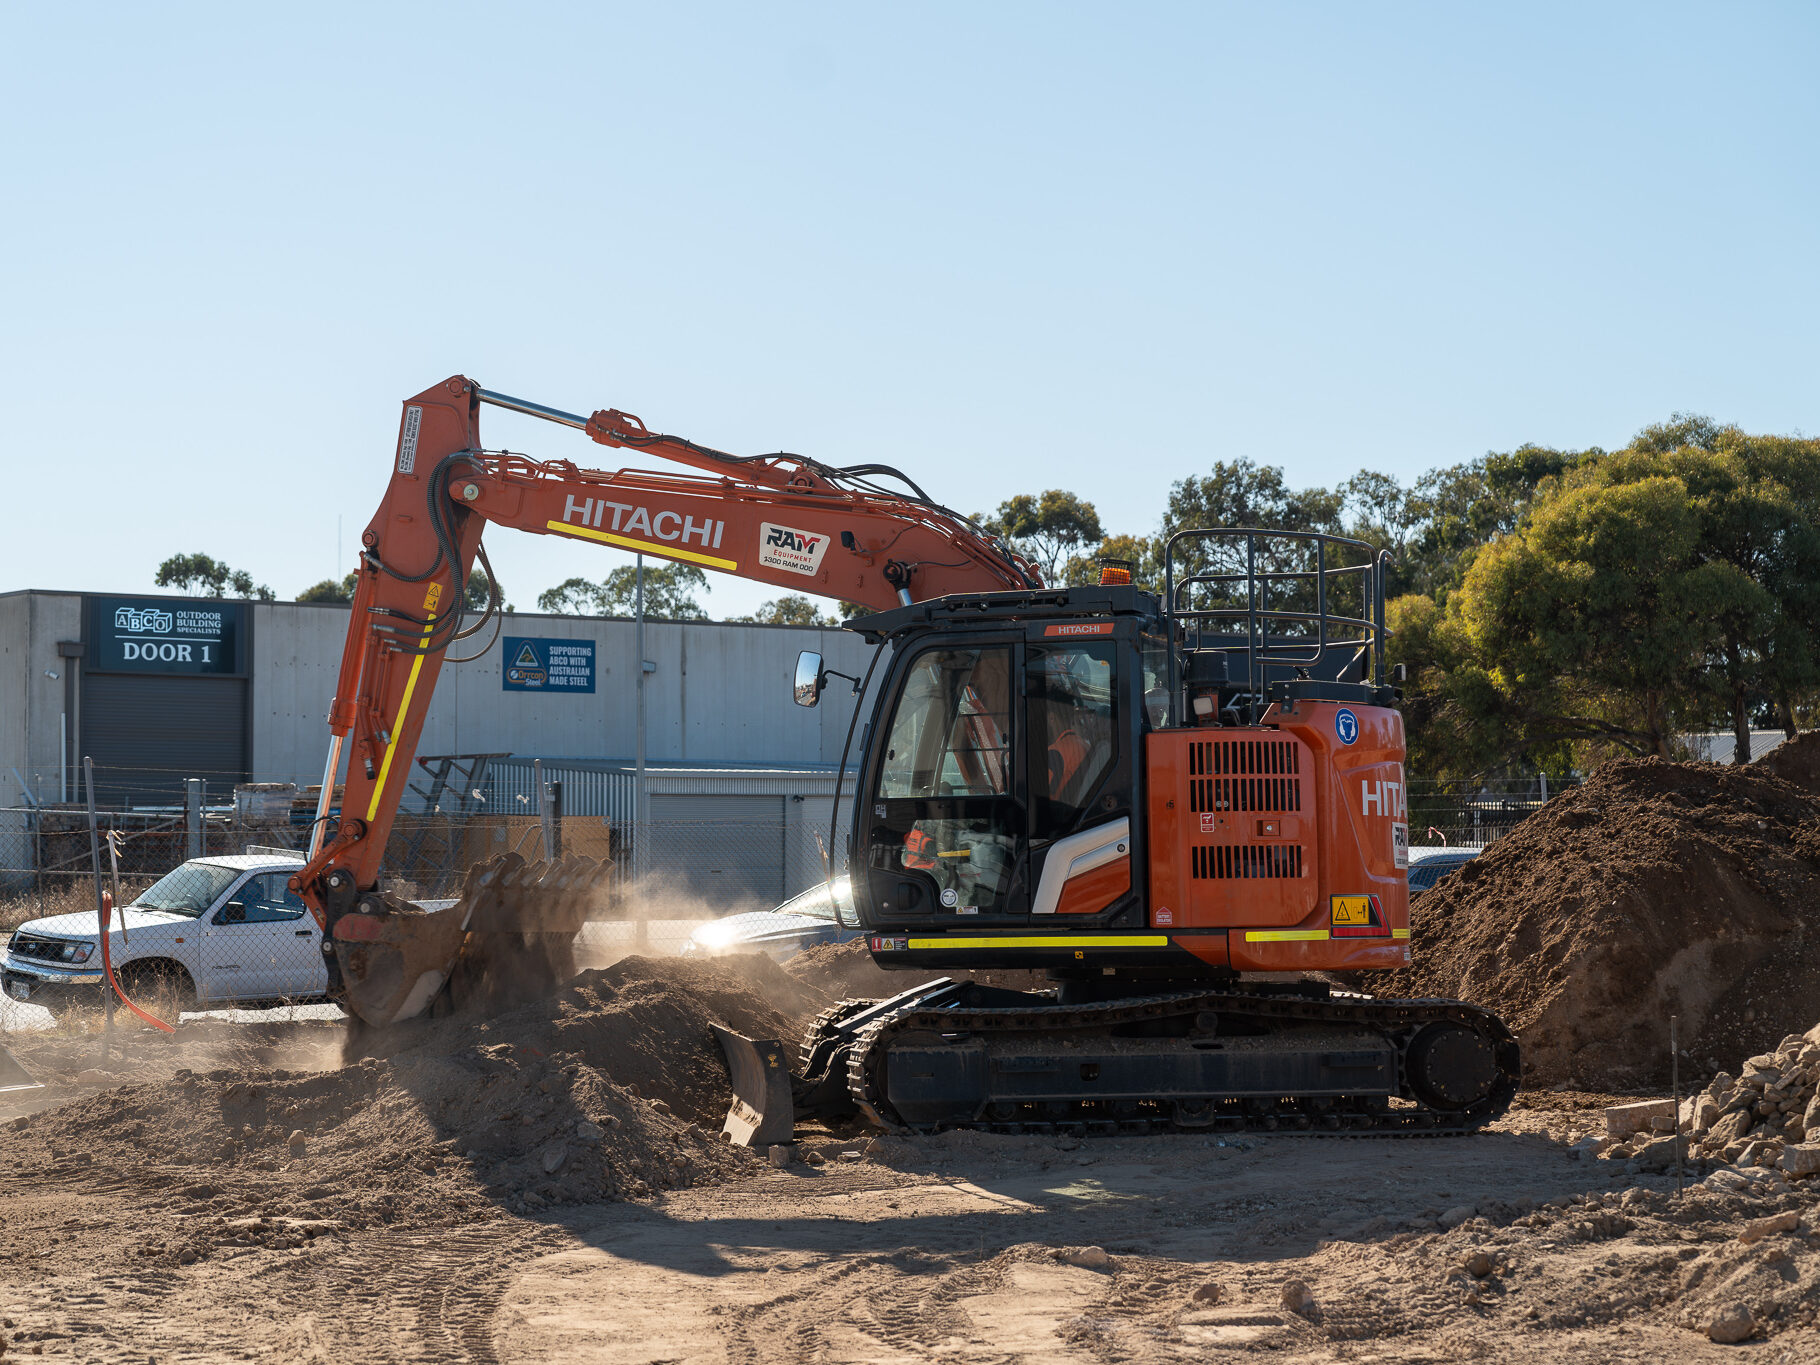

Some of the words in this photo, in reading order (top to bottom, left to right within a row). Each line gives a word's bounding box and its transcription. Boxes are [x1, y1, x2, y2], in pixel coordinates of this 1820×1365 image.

[563, 494, 725, 549] HITACHI
[766, 527, 821, 554] RAM
[773, 549, 813, 563] EQUIPMENT
[782, 560, 799, 569] RAM
[799, 563, 814, 572] 000
[176, 610, 221, 620] OUTDOOR
[116, 612, 167, 631] ABCO
[176, 618, 221, 628] BUILDING
[176, 626, 221, 635] SPECIALISTS
[1058, 625, 1100, 634] HITACHI
[123, 642, 192, 662] DOOR
[201, 645, 212, 663] 1
[549, 646, 592, 656] SUPPORTING
[549, 656, 568, 665] ABCO
[569, 656, 586, 666] WITH
[518, 670, 544, 680] Orrcon
[549, 666, 590, 676] AUSTRALIAN
[525, 678, 542, 686] Steel
[549, 676, 568, 685] MADE
[569, 677, 588, 686] STEEL
